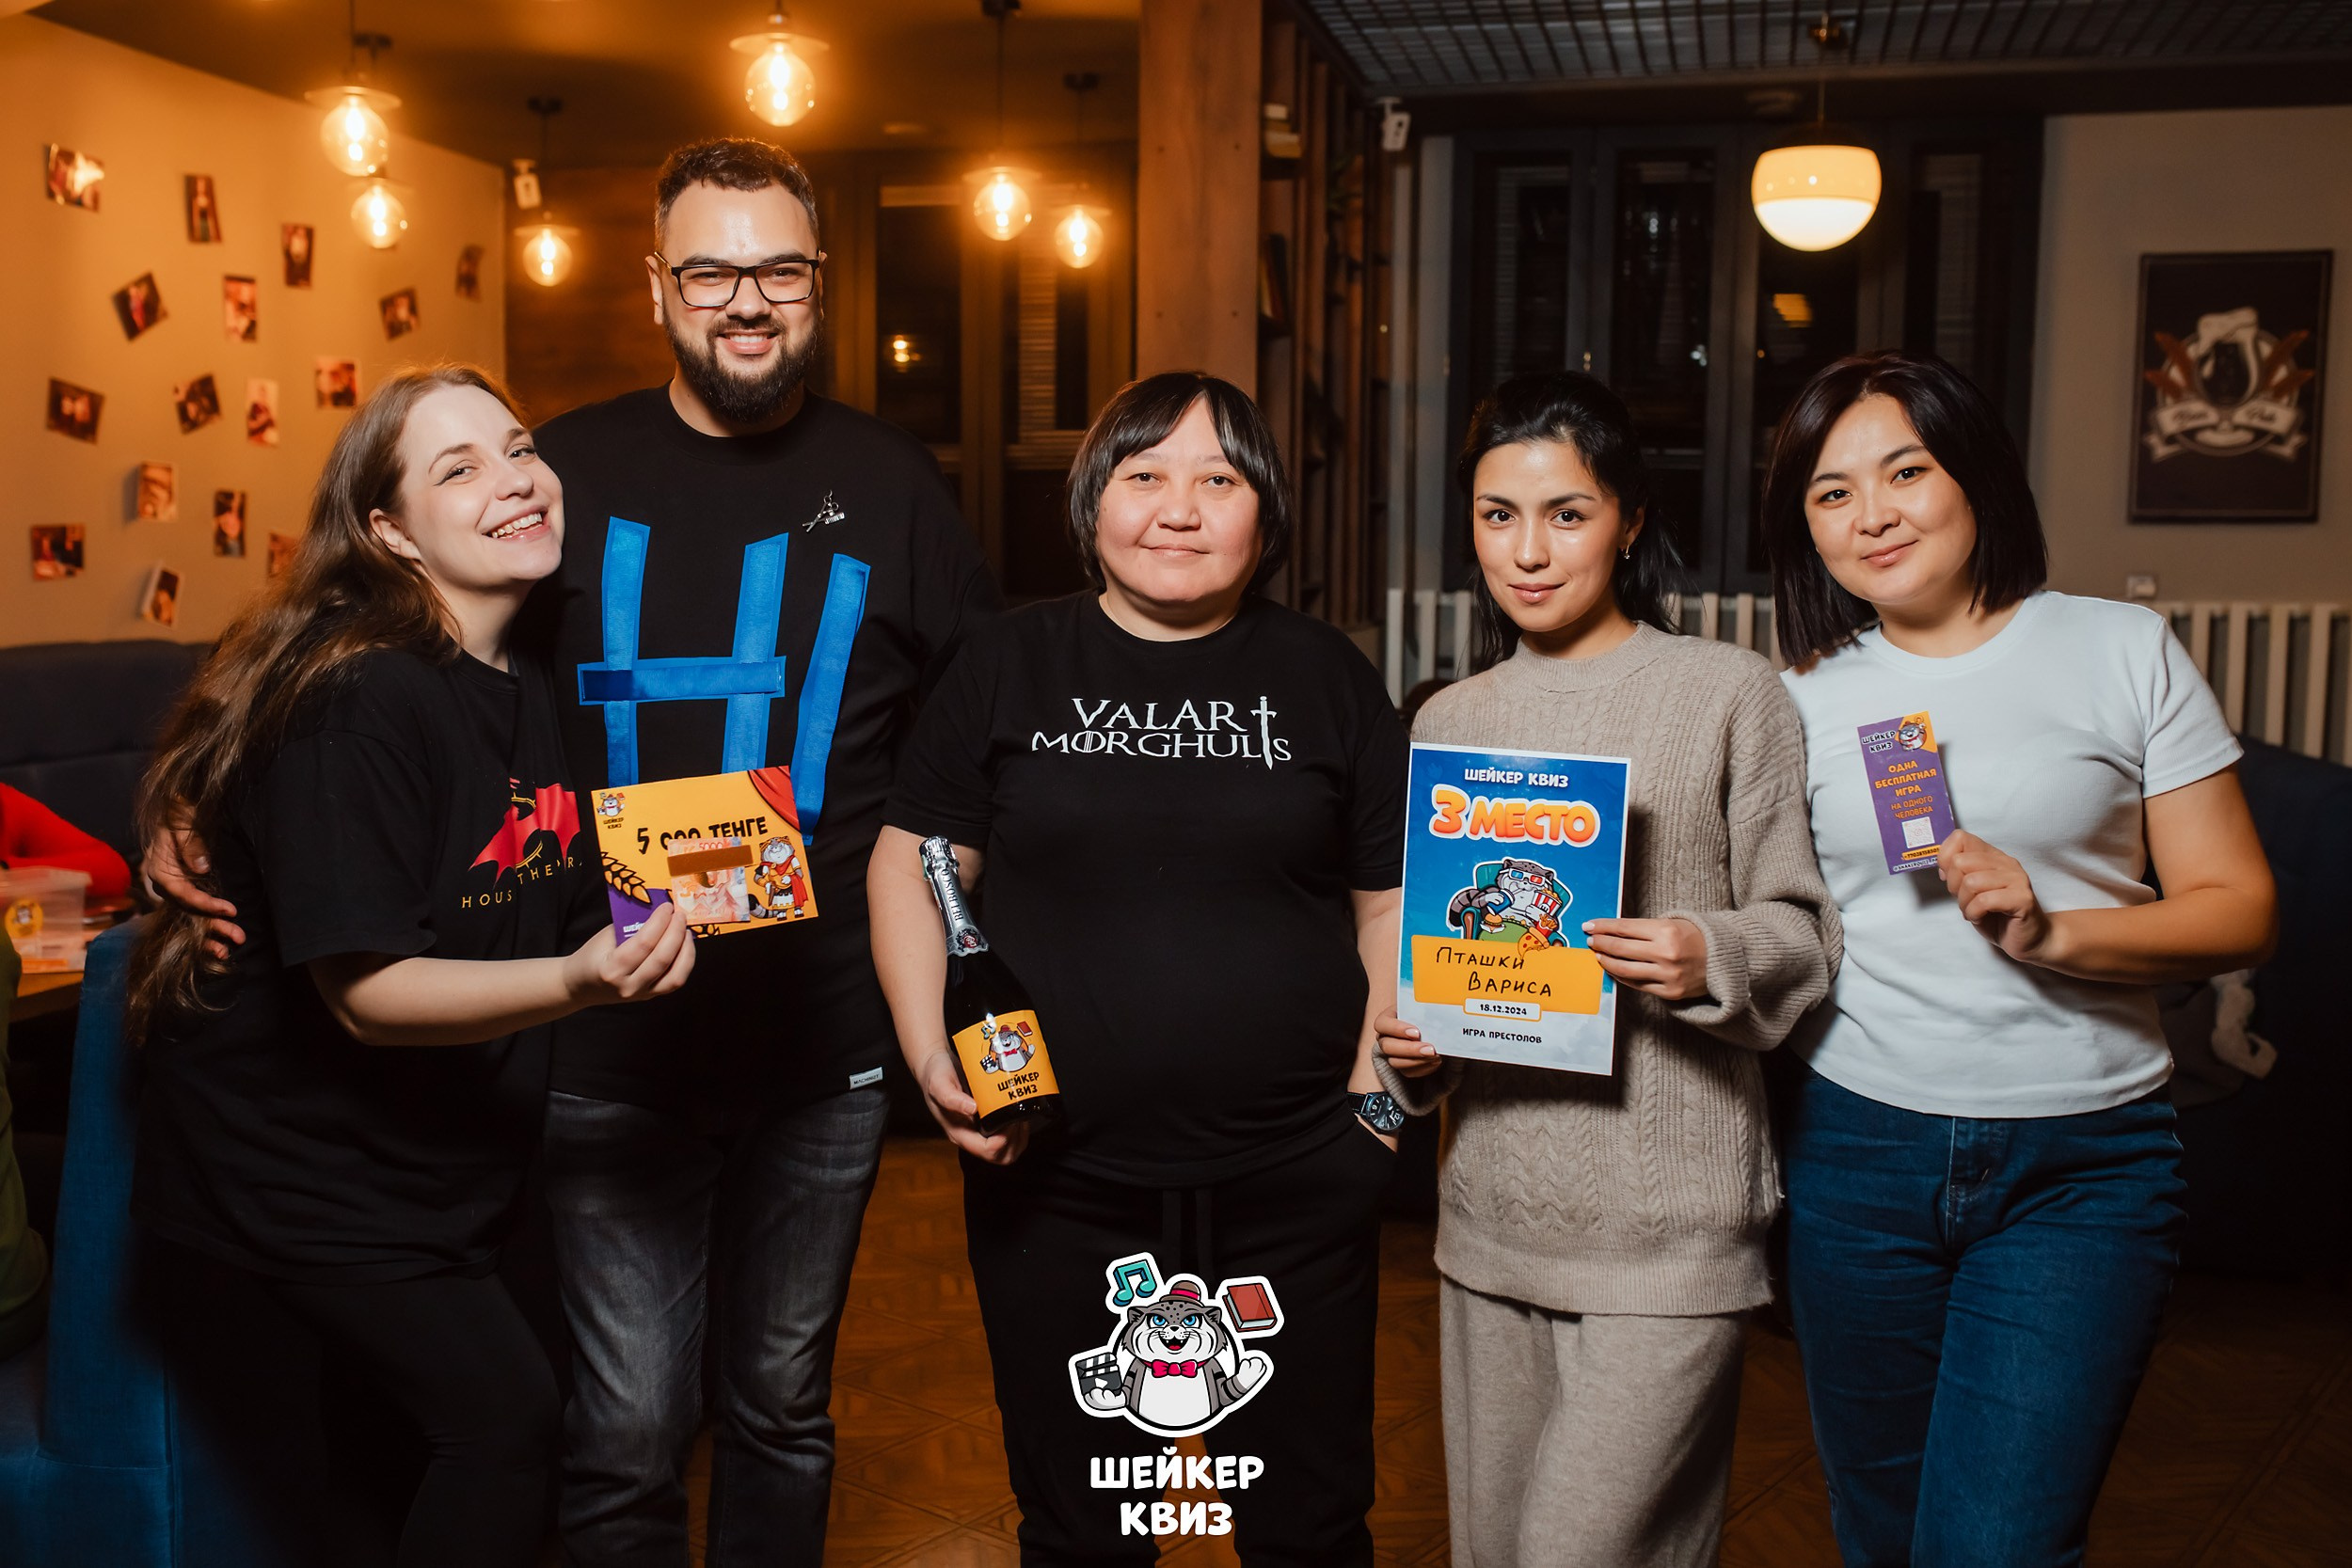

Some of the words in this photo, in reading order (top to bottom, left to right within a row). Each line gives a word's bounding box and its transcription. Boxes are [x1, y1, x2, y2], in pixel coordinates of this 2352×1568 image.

[1072, 698, 1248, 731] VALAR
[1862, 731, 1896, 744] ШЕЙКЕР
[1869, 742, 1893, 752] КВИЗ
[1888, 760, 1917, 773] ОДНА
[1464, 767, 1524, 784] ШЕЙКЕР
[1528, 772, 1569, 788] КВИЗ
[1874, 768, 1937, 789] БЕСПЛАТНАЯ
[1895, 784, 1922, 797] ИГРА
[1903, 795, 1933, 808] ОДНОГО
[1432, 787, 1468, 835] 3
[1469, 800, 1597, 844] МЕСТО
[1895, 806, 1933, 819] ЧЕЛОВЕКА
[637, 827, 650, 855] 5
[707, 816, 769, 839] ТЕНГЕ
[517, 863, 553, 884] THE
[461, 890, 513, 909] HOUS
[1479, 1003, 1528, 1016] 18.12.2024
[1462, 1027, 1486, 1037] ИГРА
[1488, 1031, 1543, 1044] ПРЕСТОЛОВ
[997, 1071, 1040, 1092] ШЕЙКЕР
[1008, 1084, 1038, 1101] КВИЗ
